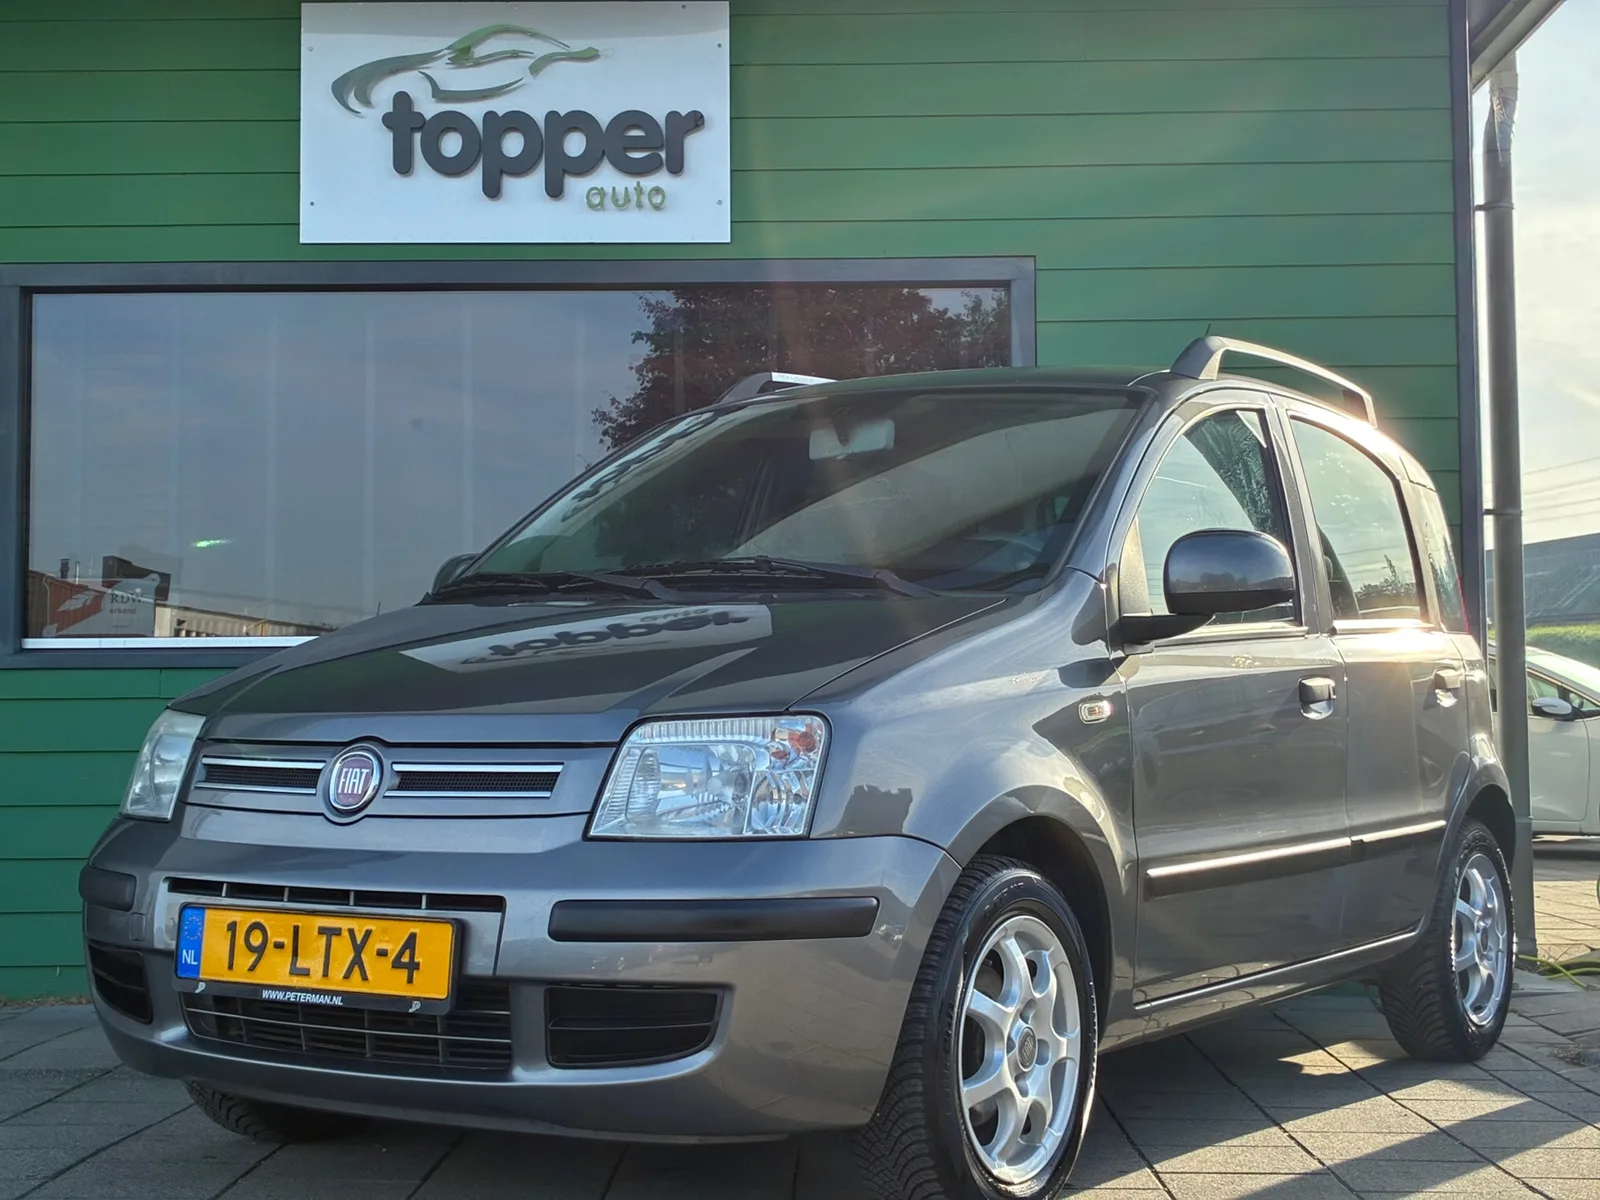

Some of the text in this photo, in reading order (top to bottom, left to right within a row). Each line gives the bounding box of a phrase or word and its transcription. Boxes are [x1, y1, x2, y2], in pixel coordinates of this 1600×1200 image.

[382, 90, 705, 199] topper
[585, 181, 667, 211] auto
[338, 767, 370, 794] FIAT
[182, 949, 198, 965] NL
[226, 920, 420, 984] 19-LTX-4
[262, 989, 343, 1006] WWW.PETERMAN.NL
